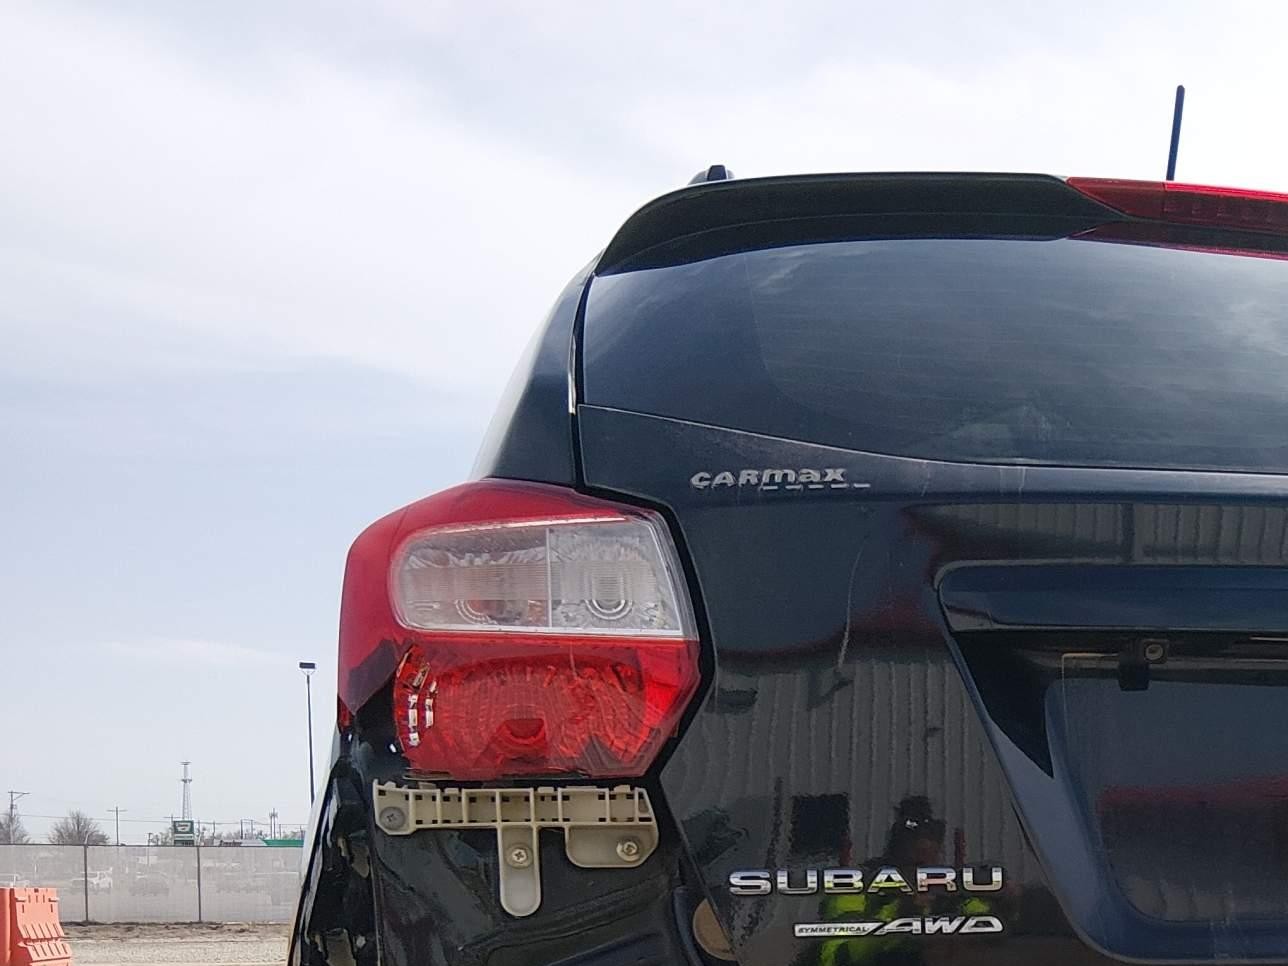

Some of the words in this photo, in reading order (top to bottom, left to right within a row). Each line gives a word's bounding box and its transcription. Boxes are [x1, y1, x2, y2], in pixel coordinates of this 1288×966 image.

[729, 867, 1003, 894] SUBARU
[798, 926, 868, 934] SYMMETRICAL
[873, 916, 1003, 936] AWD
